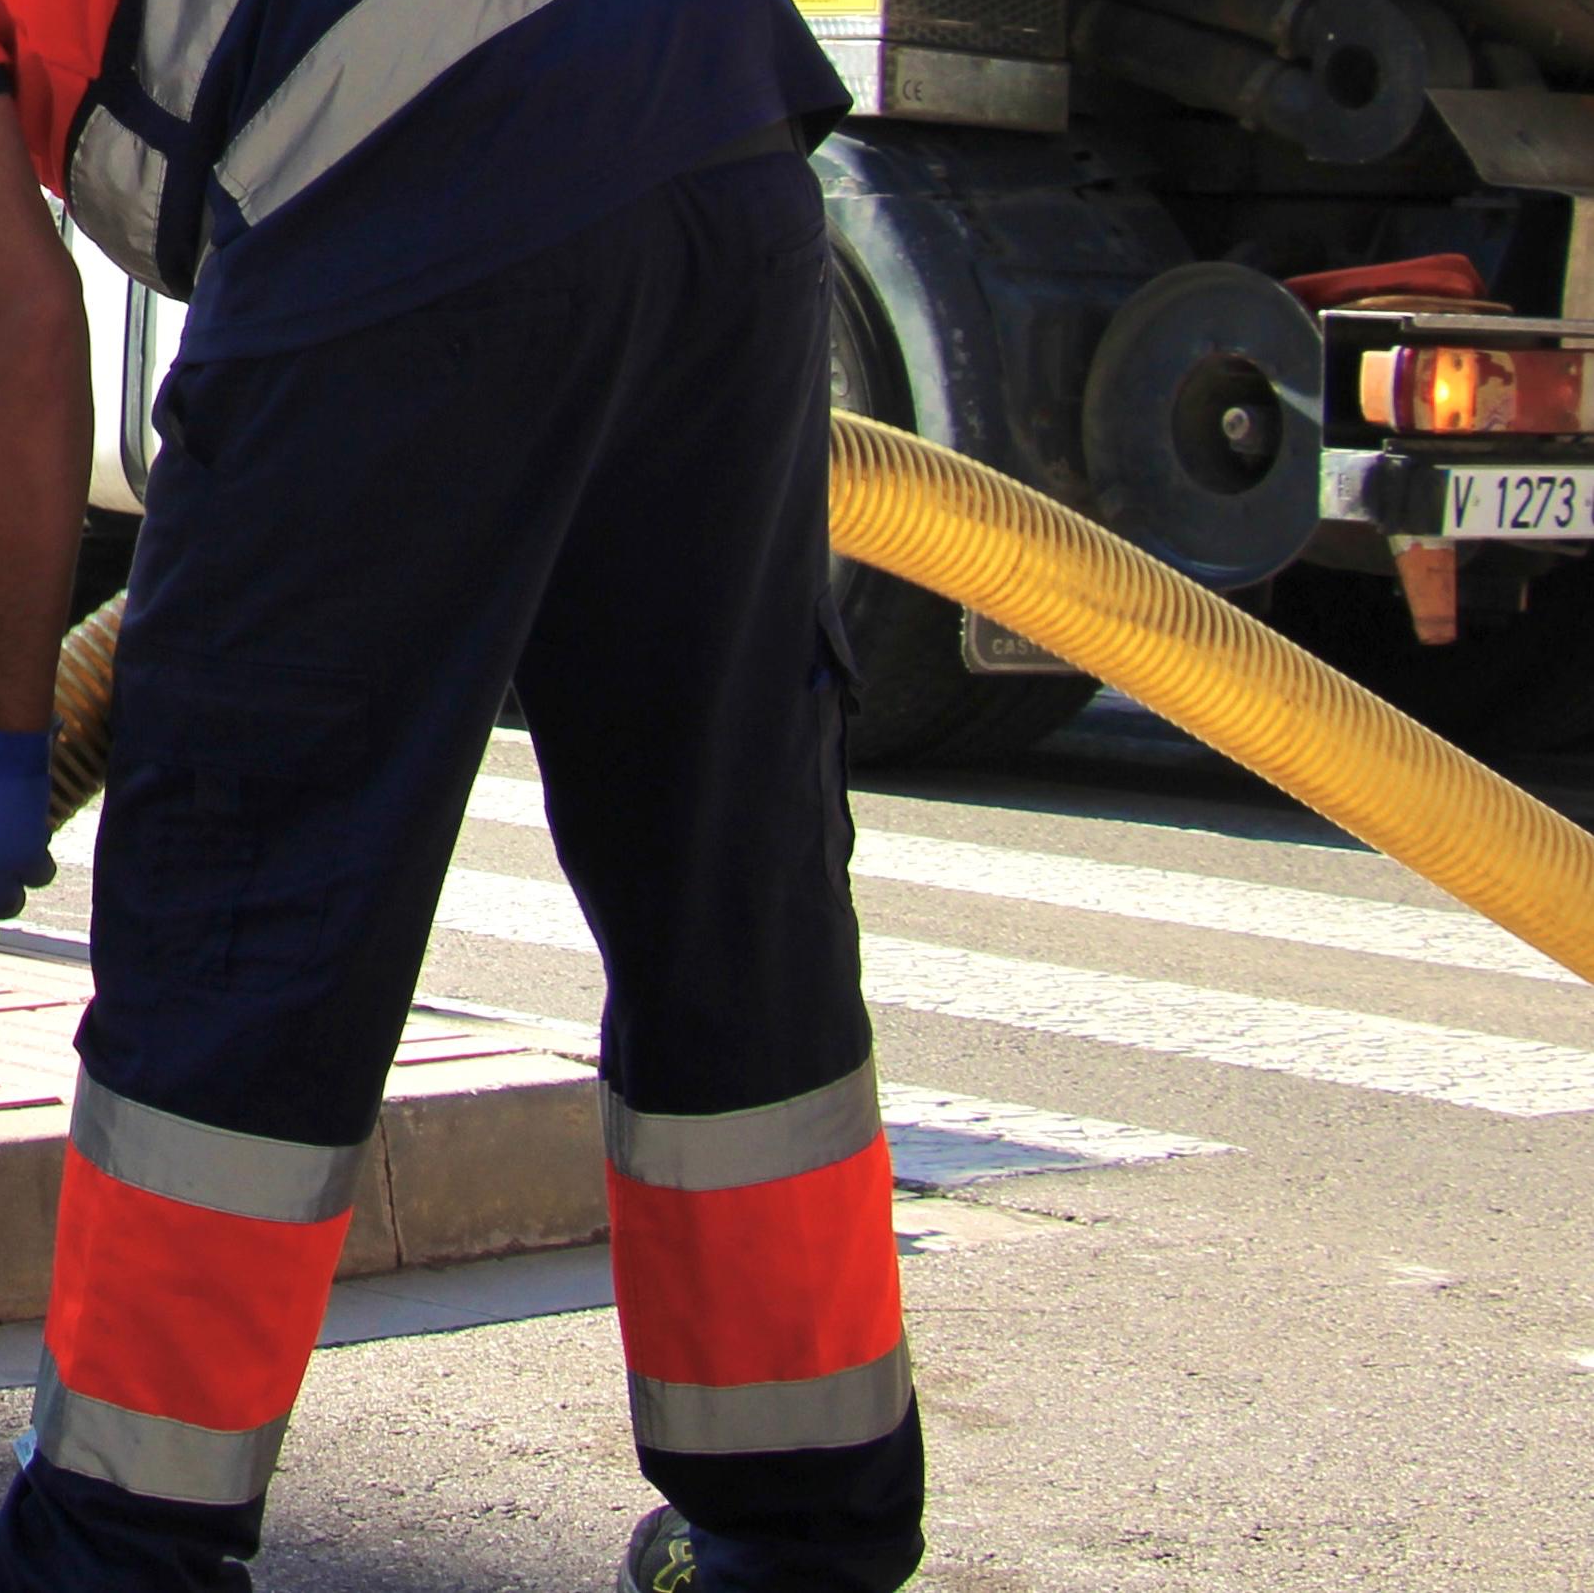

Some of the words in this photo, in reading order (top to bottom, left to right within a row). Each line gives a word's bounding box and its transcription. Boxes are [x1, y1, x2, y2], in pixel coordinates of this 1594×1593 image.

[902, 78, 924, 102] CE
[1454, 475, 1475, 528] V
[1496, 475, 1577, 529] 1273
